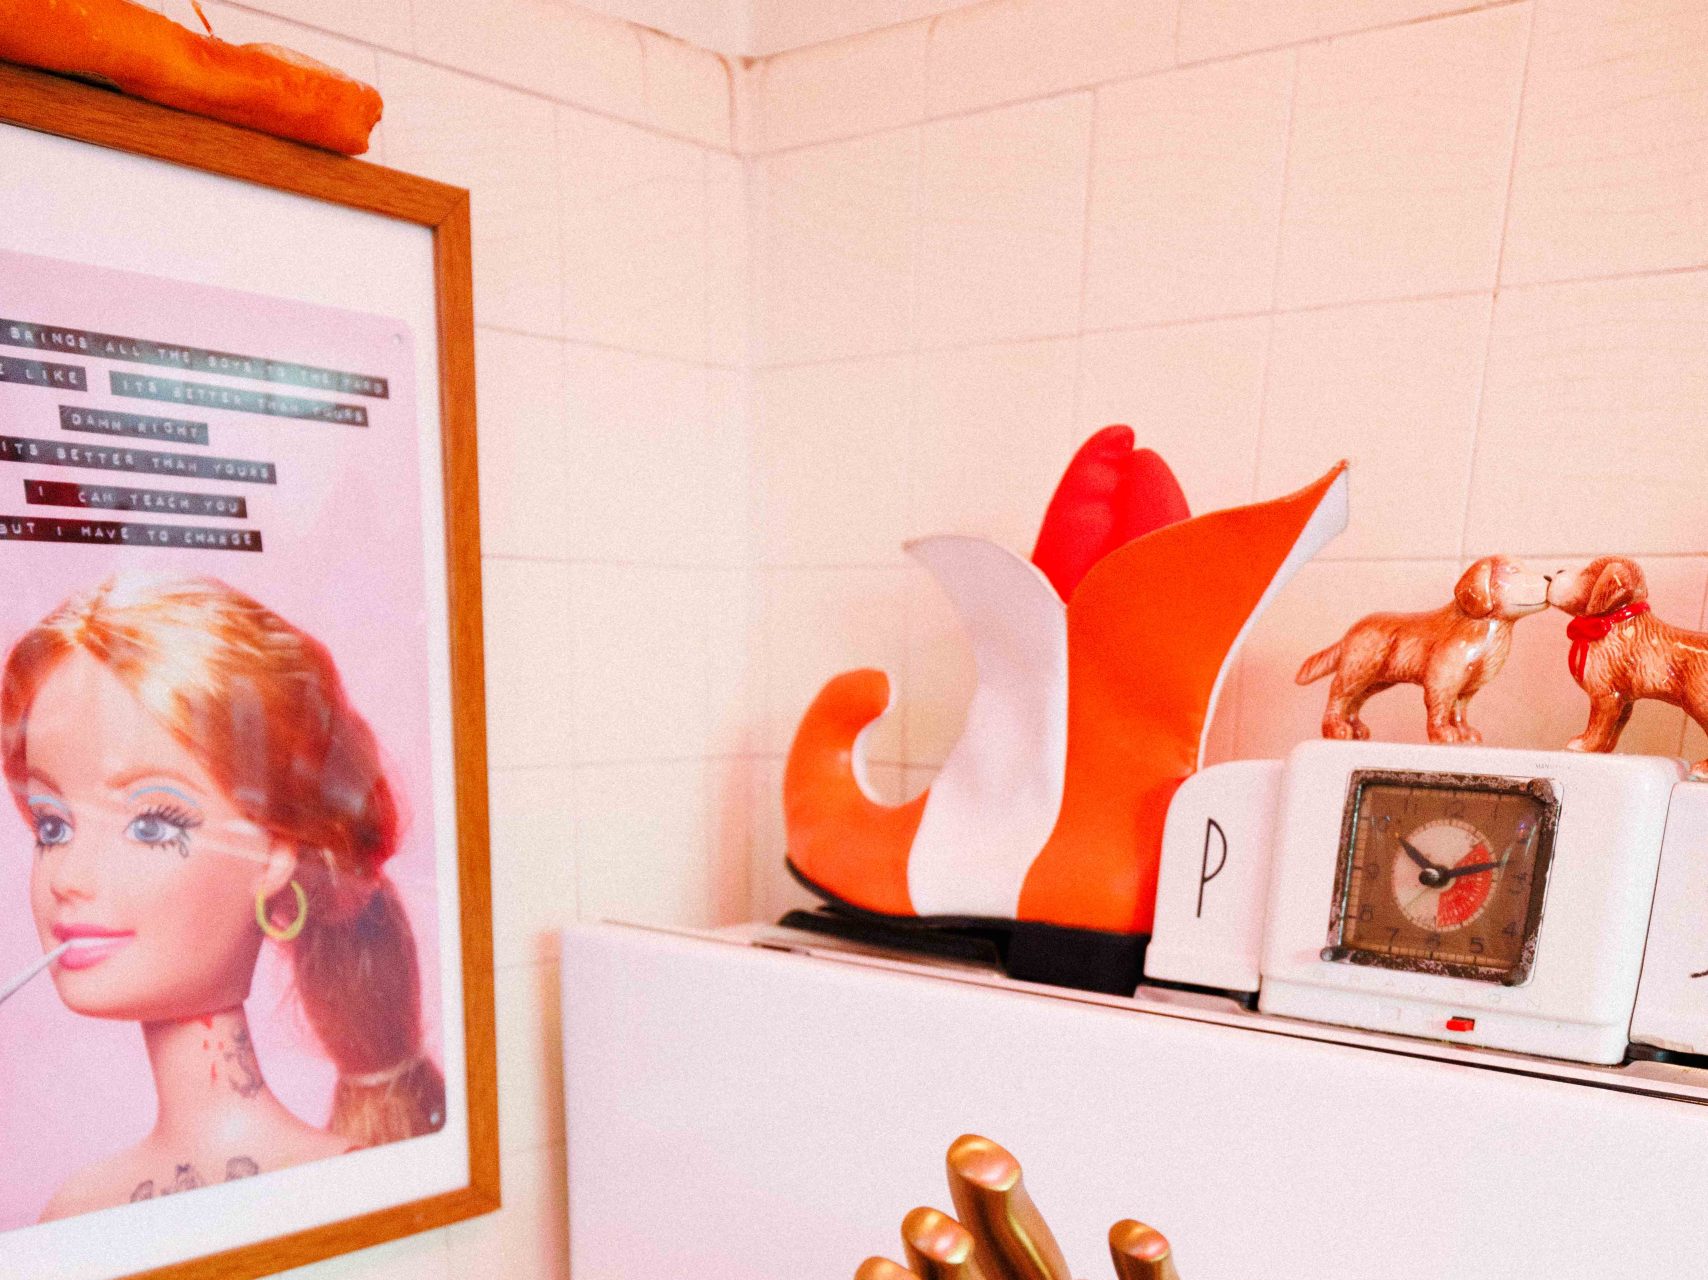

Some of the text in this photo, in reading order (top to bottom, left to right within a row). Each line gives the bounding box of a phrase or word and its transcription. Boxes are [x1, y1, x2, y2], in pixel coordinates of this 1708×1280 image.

[10, 326, 88, 350] BRINGS
[105, 341, 141, 358] ALL
[158, 348, 190, 364] THE
[208, 355, 251, 373] BOYS
[26, 368, 78, 385] LIKE
[123, 379, 158, 394] ITS
[313, 405, 363, 422] YOURS
[72, 412, 198, 439] DAMN RIGHT
[1, 440, 270, 480] ITS BETTER THAN YOURS
[78, 490, 114, 504] CAN
[130, 494, 190, 509] TEACH
[204, 500, 240, 514] YOU
[81, 525, 129, 540] HAVE
[147, 529, 169, 542] TO
[184, 531, 253, 547] CHARGE
[1196, 817, 1228, 919] P
[1502, 921, 1518, 941] 4
[1470, 936, 1485, 954] 5
